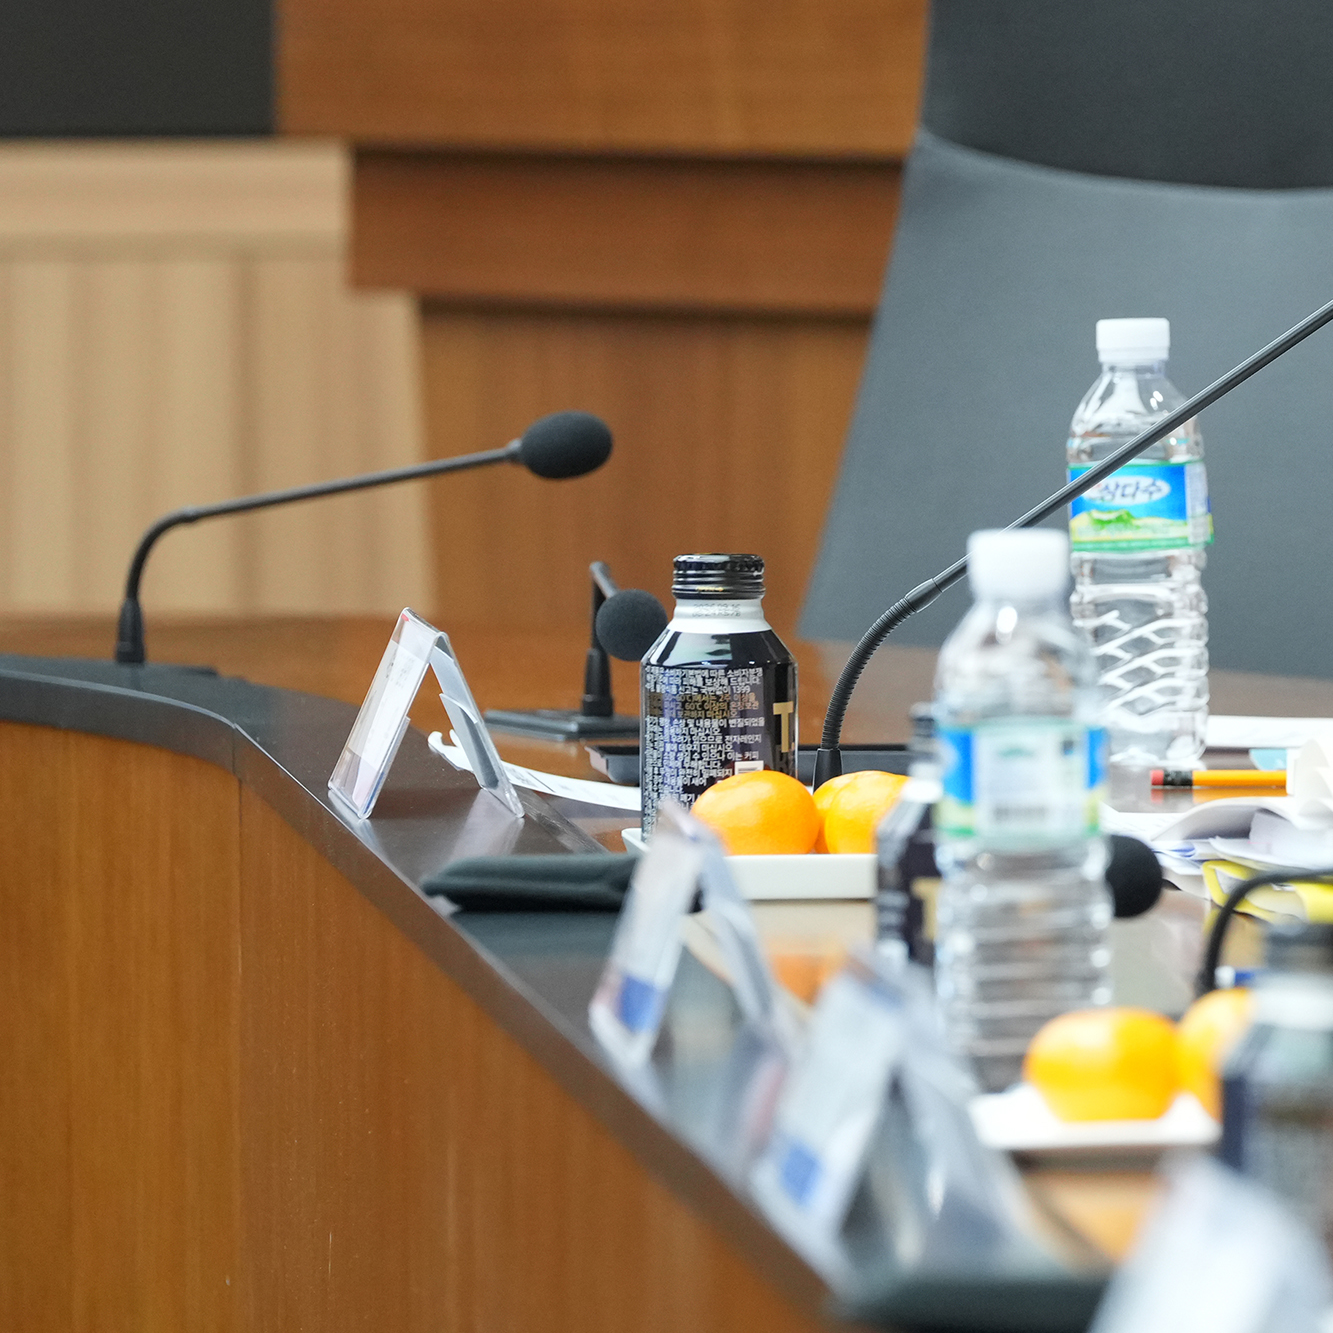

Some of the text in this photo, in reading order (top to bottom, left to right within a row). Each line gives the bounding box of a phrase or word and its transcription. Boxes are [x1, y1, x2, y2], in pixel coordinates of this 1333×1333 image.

[733, 685, 751, 694] 1399
[719, 693, 731, 702] 2주
[703, 701, 728, 711] 이상의
[696, 718, 727, 728] 내용물이
[692, 734, 723, 744] 있으므로
[724, 734, 762, 744] 전자레인지
[692, 752, 700, 762] 수
[701, 751, 726, 761] 있으나
[727, 751, 743, 760] 이는
[744, 750, 759, 759] 커피
